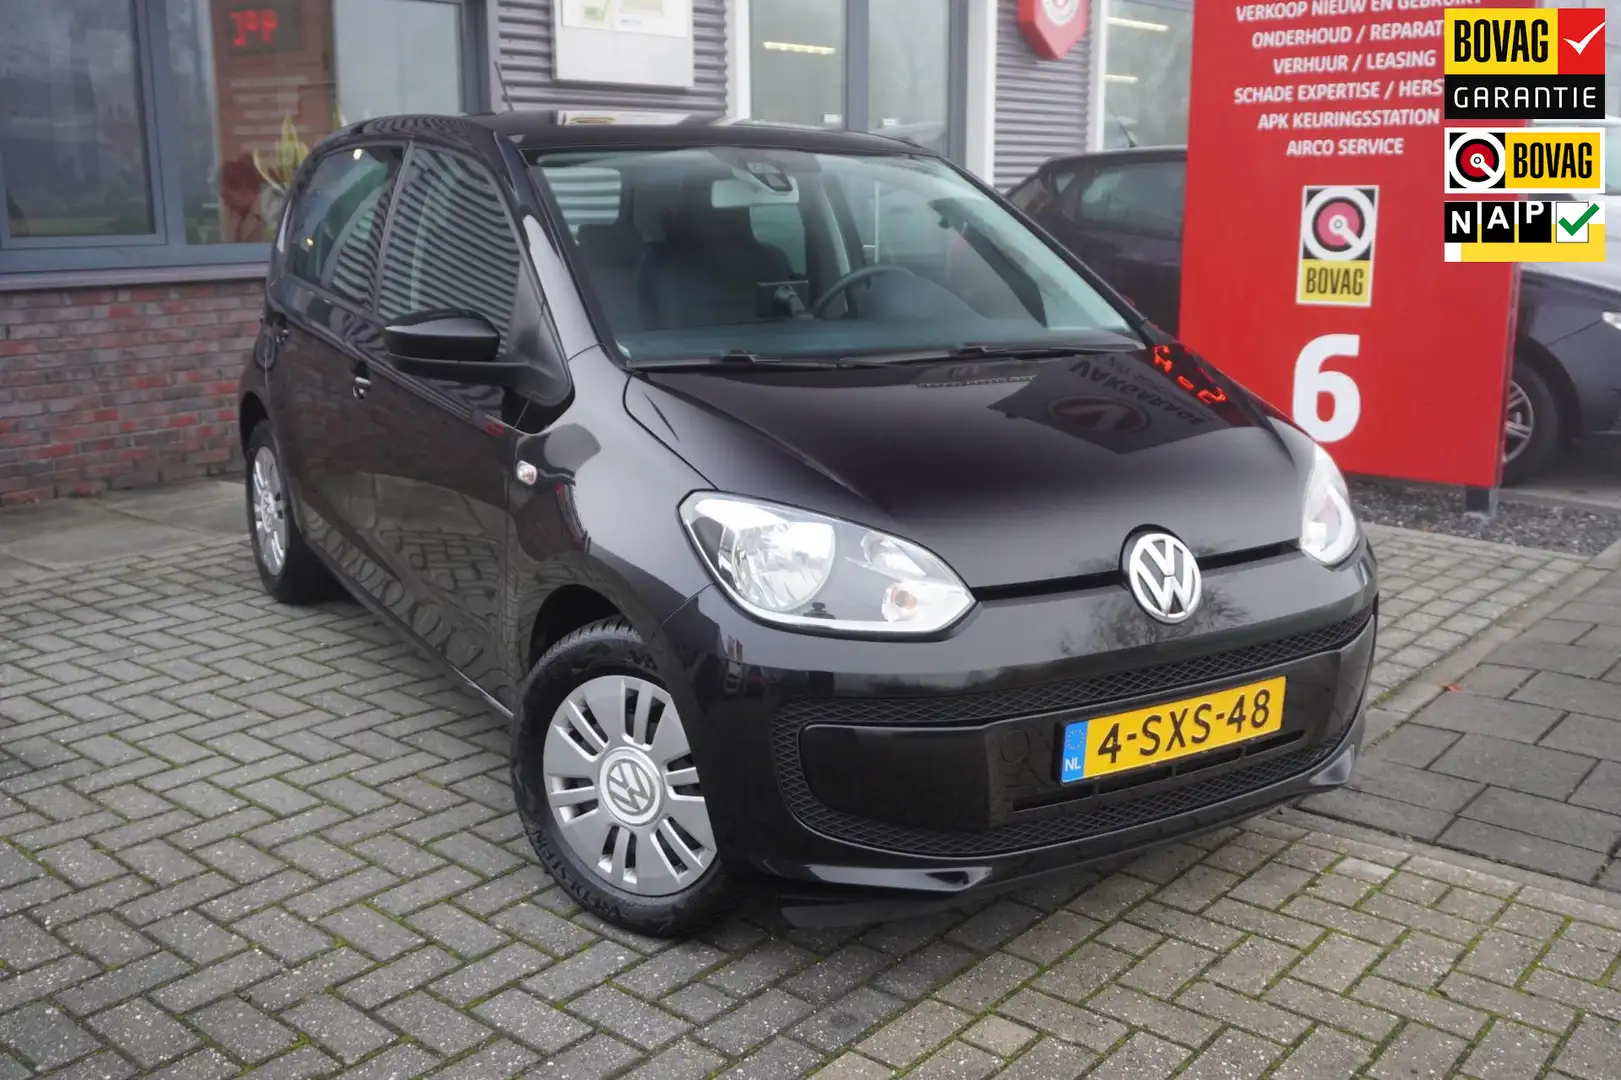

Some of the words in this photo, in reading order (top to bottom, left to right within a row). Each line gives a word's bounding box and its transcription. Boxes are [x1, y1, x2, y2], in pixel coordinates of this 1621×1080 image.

[1236, 2, 1309, 22] VERKOOP
[1311, 0, 1366, 16] NIEUW
[1371, 0, 1393, 12] EN
[1252, 26, 1351, 48] ONDERHOUD
[1356, 24, 1366, 44] /
[1273, 54, 1348, 75] VERHUUR
[1352, 54, 1362, 72] /
[1366, 50, 1437, 69] LEASING
[1234, 85, 1293, 104] SCHADE
[1298, 81, 1380, 101] EXPERTISE
[1384, 81, 1395, 101] /
[1398, 78, 1444, 97] HERS
[1257, 113, 1288, 130] APK
[1293, 108, 1440, 129] KEURINGSSTATION
[1285, 139, 1334, 157] AIRCO
[1338, 137, 1404, 155] SERVICE
[1306, 267, 1364, 296] BOVAG
[1292, 334, 1361, 443] 6
[1097, 688, 1271, 764] 4-SXS-48
[1064, 756, 1081, 771] NL
